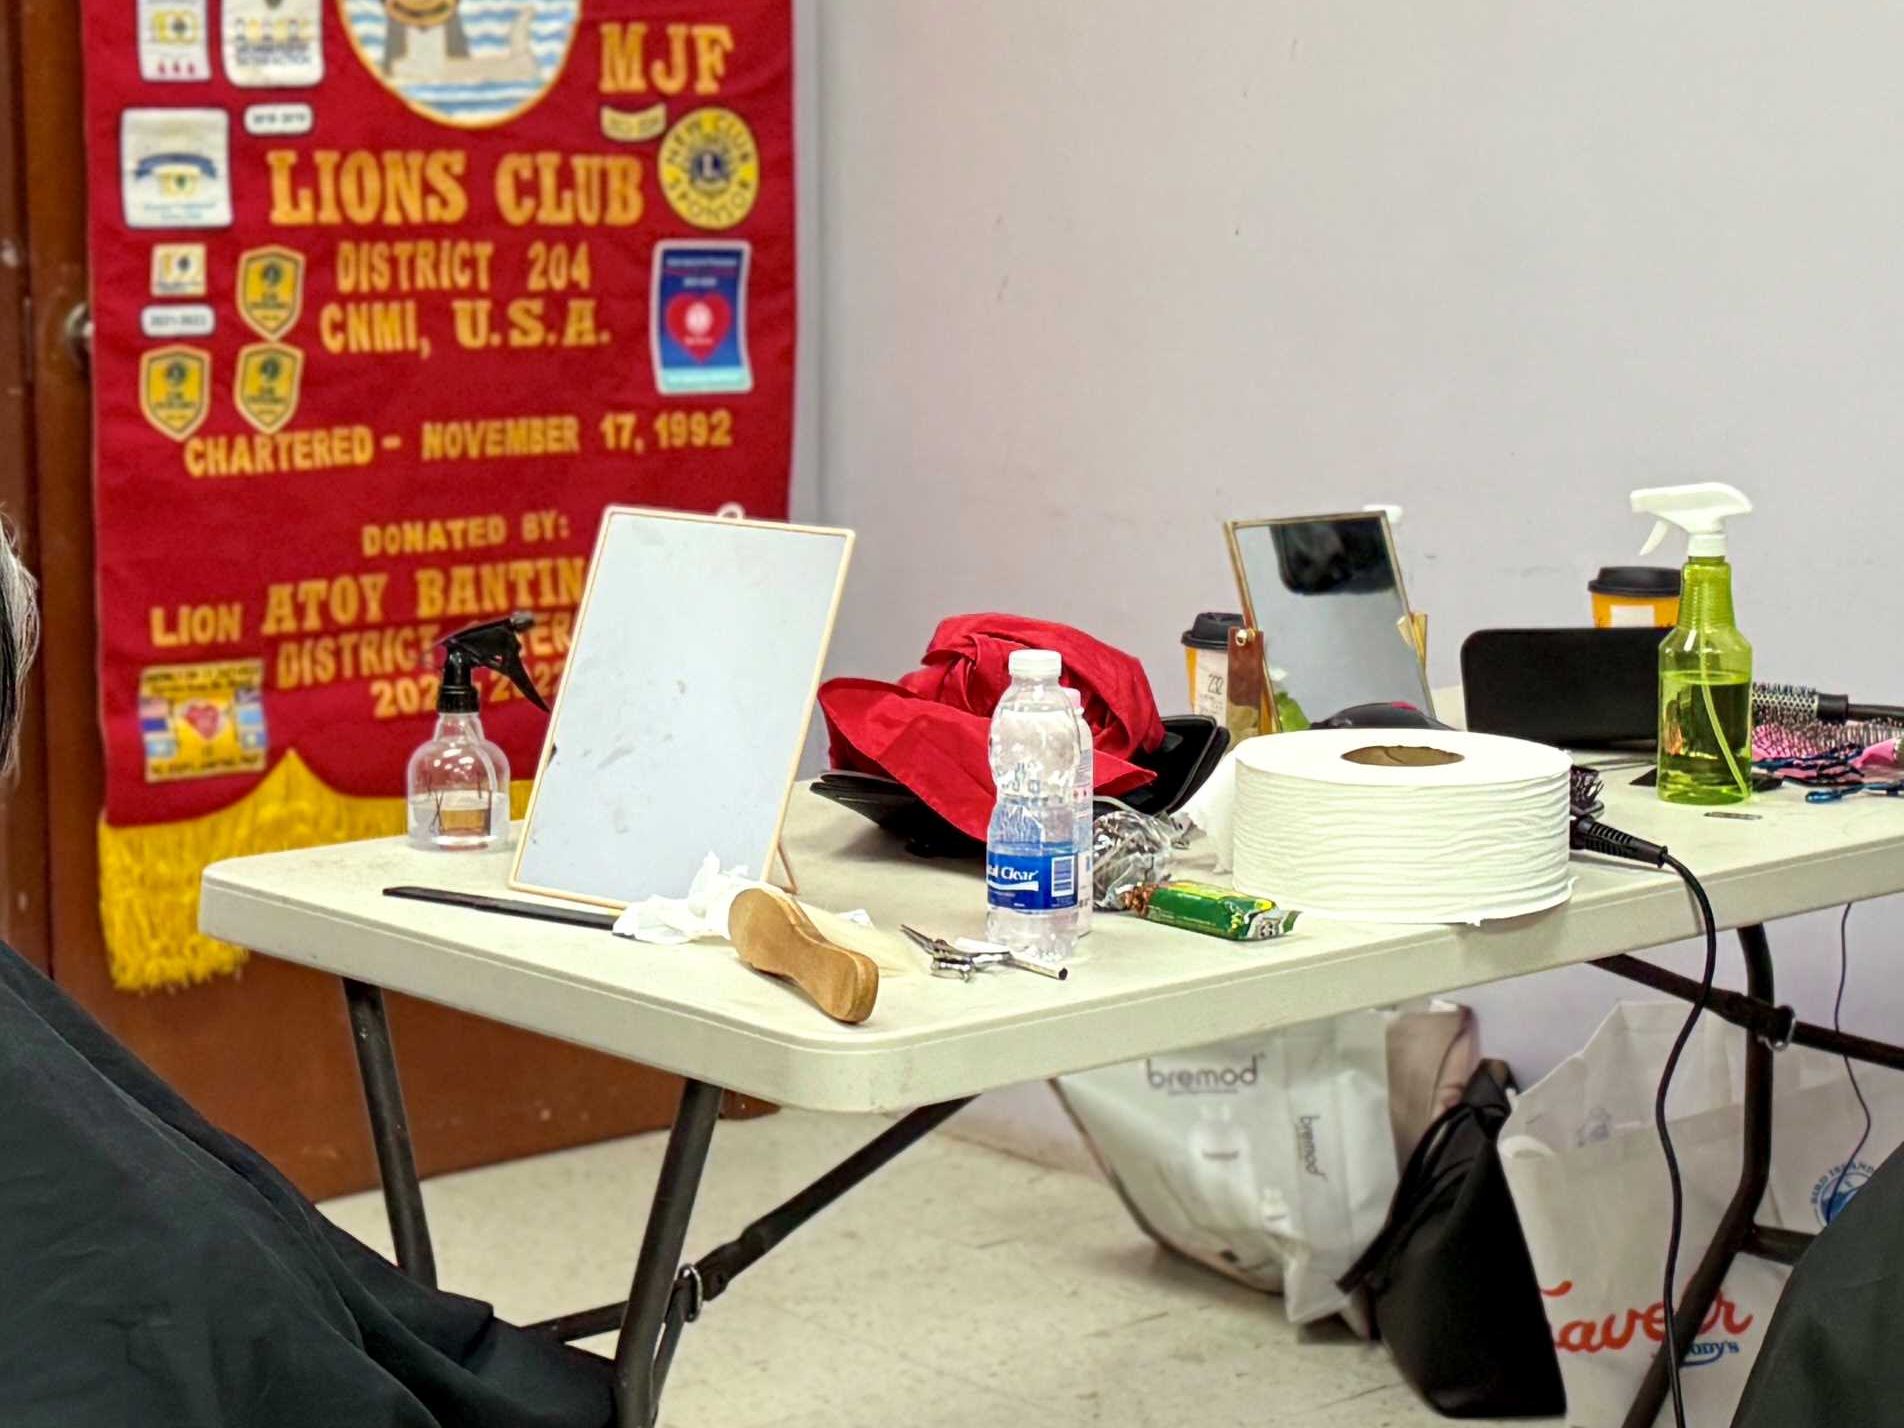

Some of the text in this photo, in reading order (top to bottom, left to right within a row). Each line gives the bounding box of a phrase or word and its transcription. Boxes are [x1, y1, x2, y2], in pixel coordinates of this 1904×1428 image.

[599, 22, 735, 96] MJF
[266, 150, 645, 227] LIONS CLUB
[336, 238, 591, 294] DISTRICT 204
[319, 297, 611, 360] CNMI, U.S.A.
[183, 425, 375, 478] CHARTERED
[421, 416, 581, 461] NOVEMBER
[600, 412, 645, 454] 17,
[653, 410, 732, 450] 1992
[361, 510, 570, 557] DONATED BY:
[149, 602, 242, 648] LION
[261, 573, 389, 637] ATOY
[1001, 865, 1040, 881] Clear
[1146, 1054, 1259, 1089] bremod
